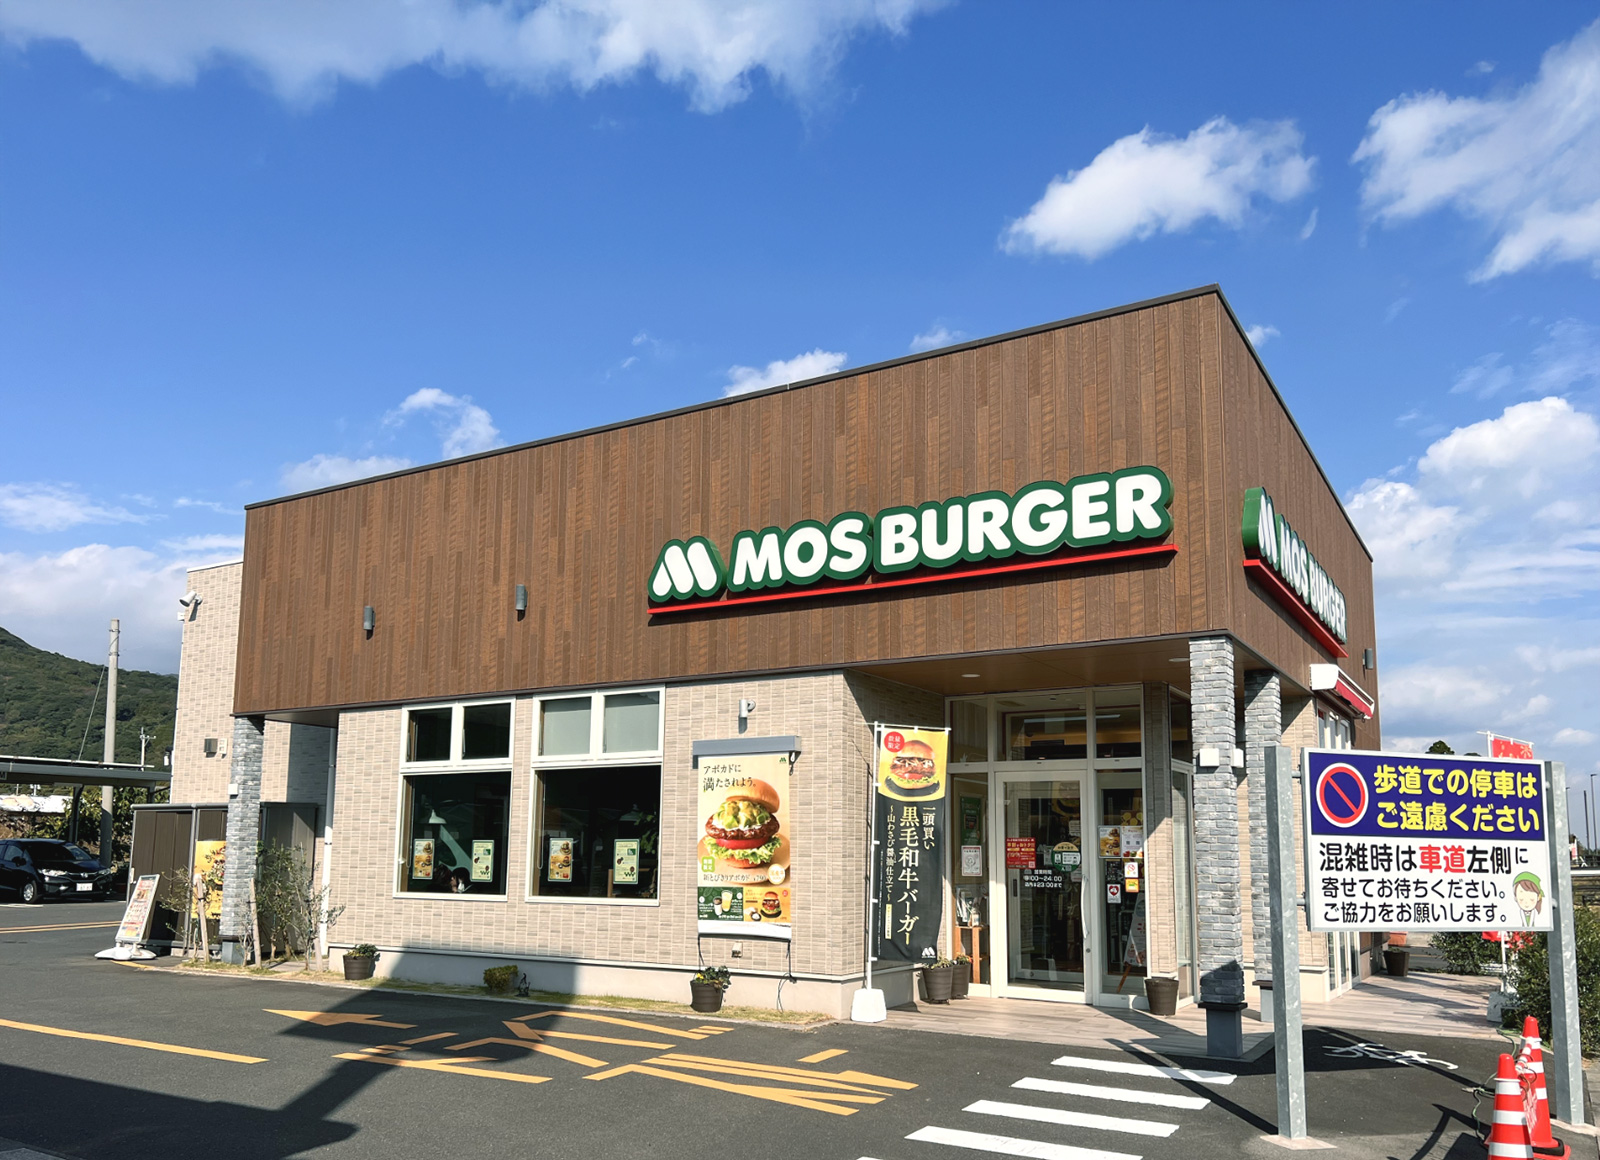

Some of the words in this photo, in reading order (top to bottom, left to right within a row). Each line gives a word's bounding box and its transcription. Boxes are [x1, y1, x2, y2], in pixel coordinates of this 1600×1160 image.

[732, 518, 867, 586] MOS
[880, 473, 1163, 567] BURGER
[1280, 520, 1309, 600] MOS
[1308, 558, 1346, 638] BURGER
[703, 764, 742, 774] アボカドに
[703, 777, 757, 792] 満たされよう。
[1373, 764, 1538, 799] 歩道での停車は
[922, 806, 936, 851] 一頭買い
[1376, 801, 1540, 833] ご遠慮ください
[897, 805, 919, 945] 黒毛和牛バーガー
[1319, 842, 1529, 875] 混雑時は車道左側に
[1321, 877, 1506, 899] 寄せてお待ちください。
[1323, 902, 1507, 923] ご協力をお願いします。
